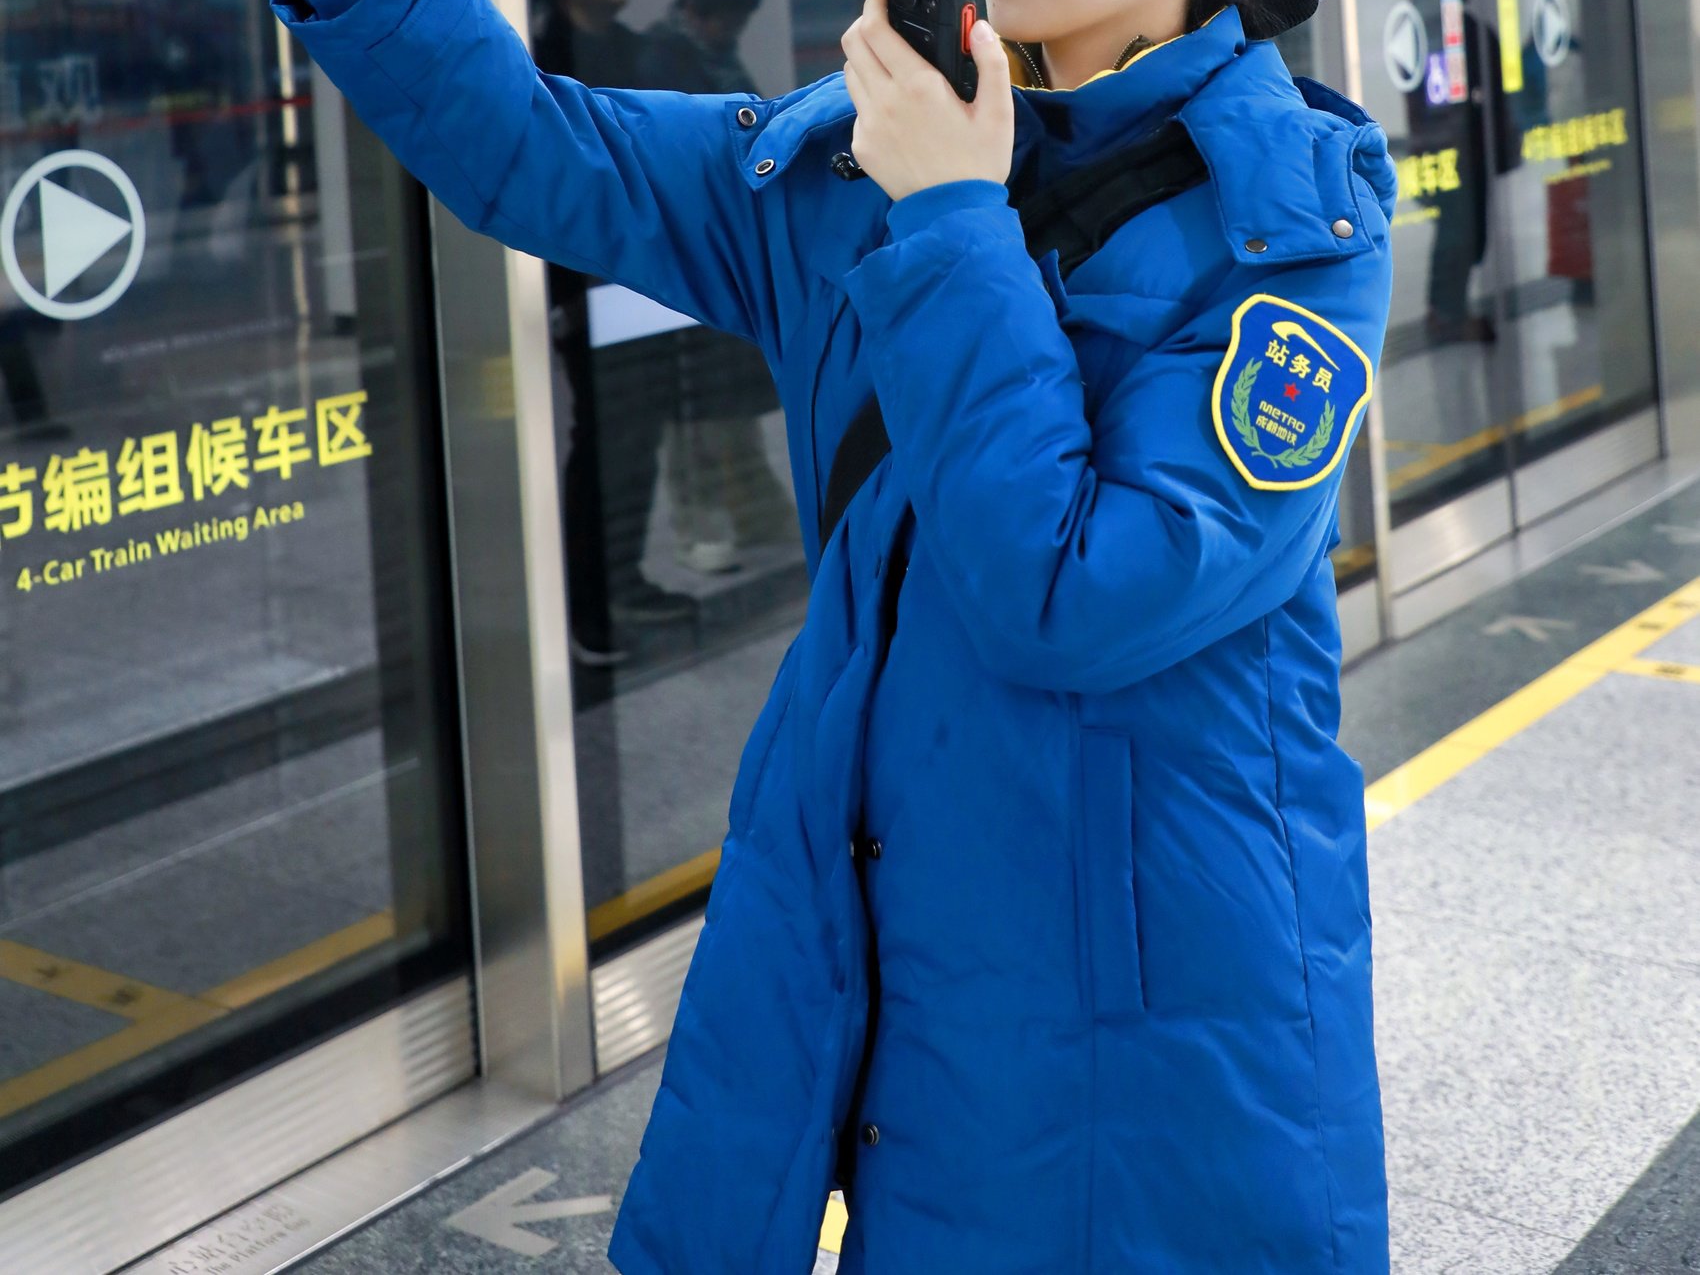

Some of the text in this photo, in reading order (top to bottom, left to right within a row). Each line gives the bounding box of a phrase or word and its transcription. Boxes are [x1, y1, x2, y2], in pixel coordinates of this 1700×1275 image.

[1265, 339, 1333, 393] 站务员
[1256, 415, 1297, 444] 成都地铁
[16, 501, 305, 592] 4-Car Train Waiting Area
